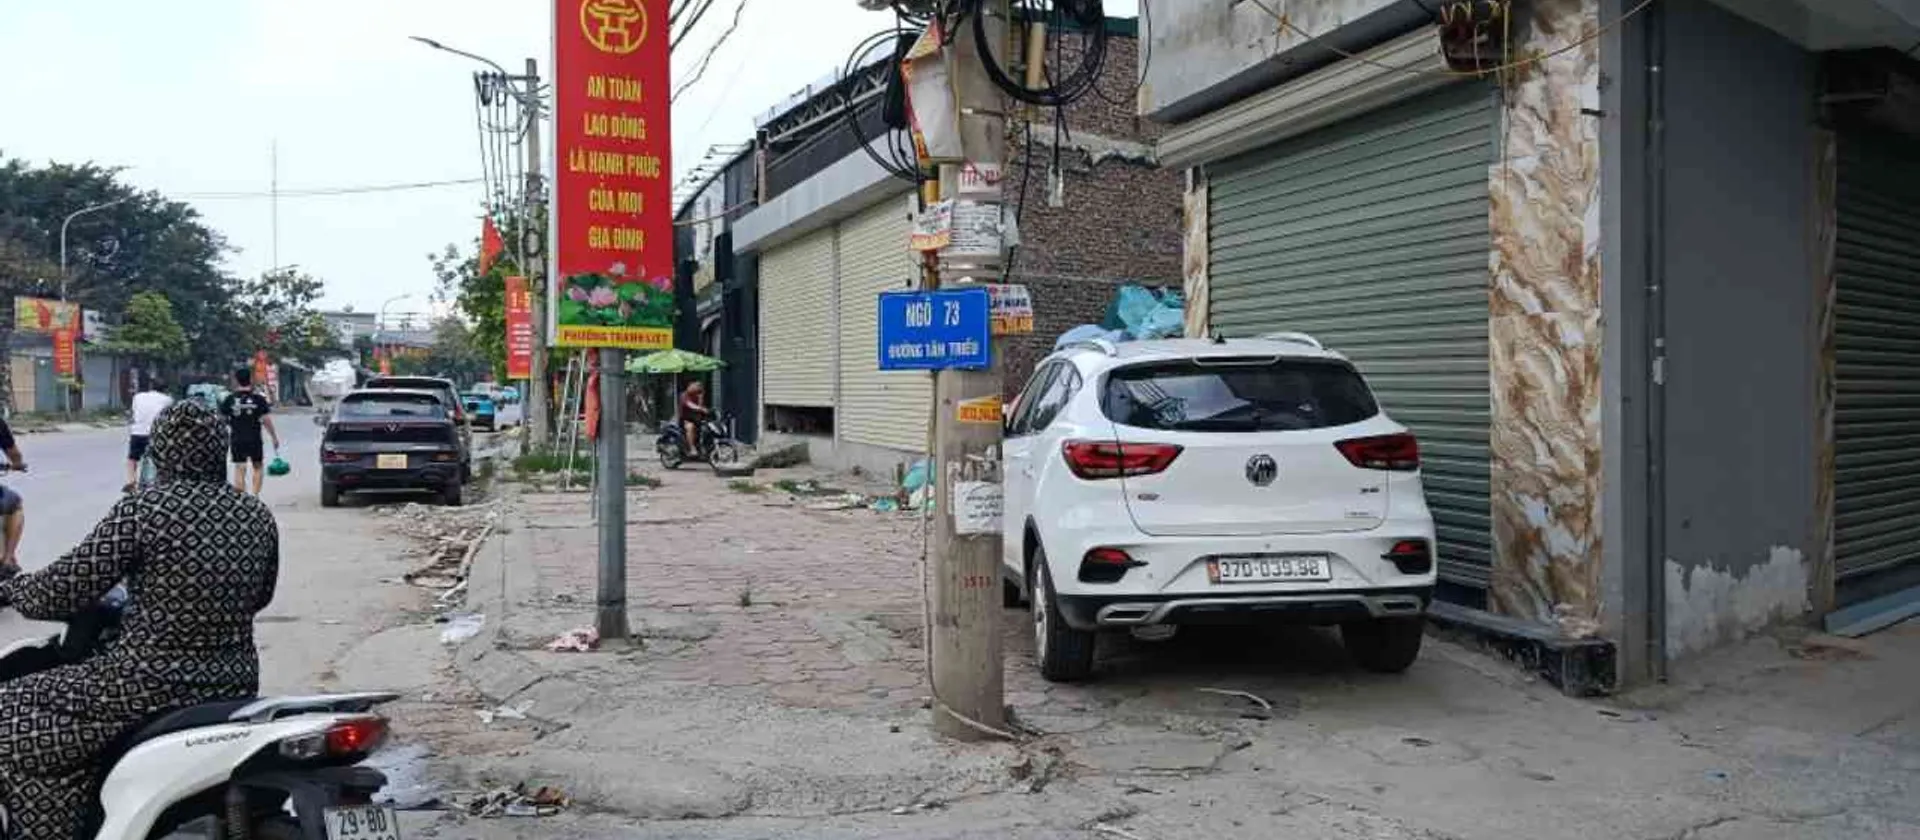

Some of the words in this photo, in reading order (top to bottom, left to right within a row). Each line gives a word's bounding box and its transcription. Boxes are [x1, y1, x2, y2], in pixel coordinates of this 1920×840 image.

[588, 74, 605, 98] AN
[583, 112, 608, 137] LAO
[611, 112, 646, 143] ĐỘNG
[570, 145, 585, 172] LÀ
[589, 150, 624, 180] HẠNH
[626, 151, 661, 179] PHÚC
[589, 181, 615, 212] CỦA
[617, 190, 643, 219] MỌI
[588, 226, 610, 249] GIA
[613, 222, 644, 252] ĐÌNH
[906, 296, 932, 328] NGÕ
[943, 299, 960, 327] 73
[888, 340, 924, 359] ĐƯỜNG
